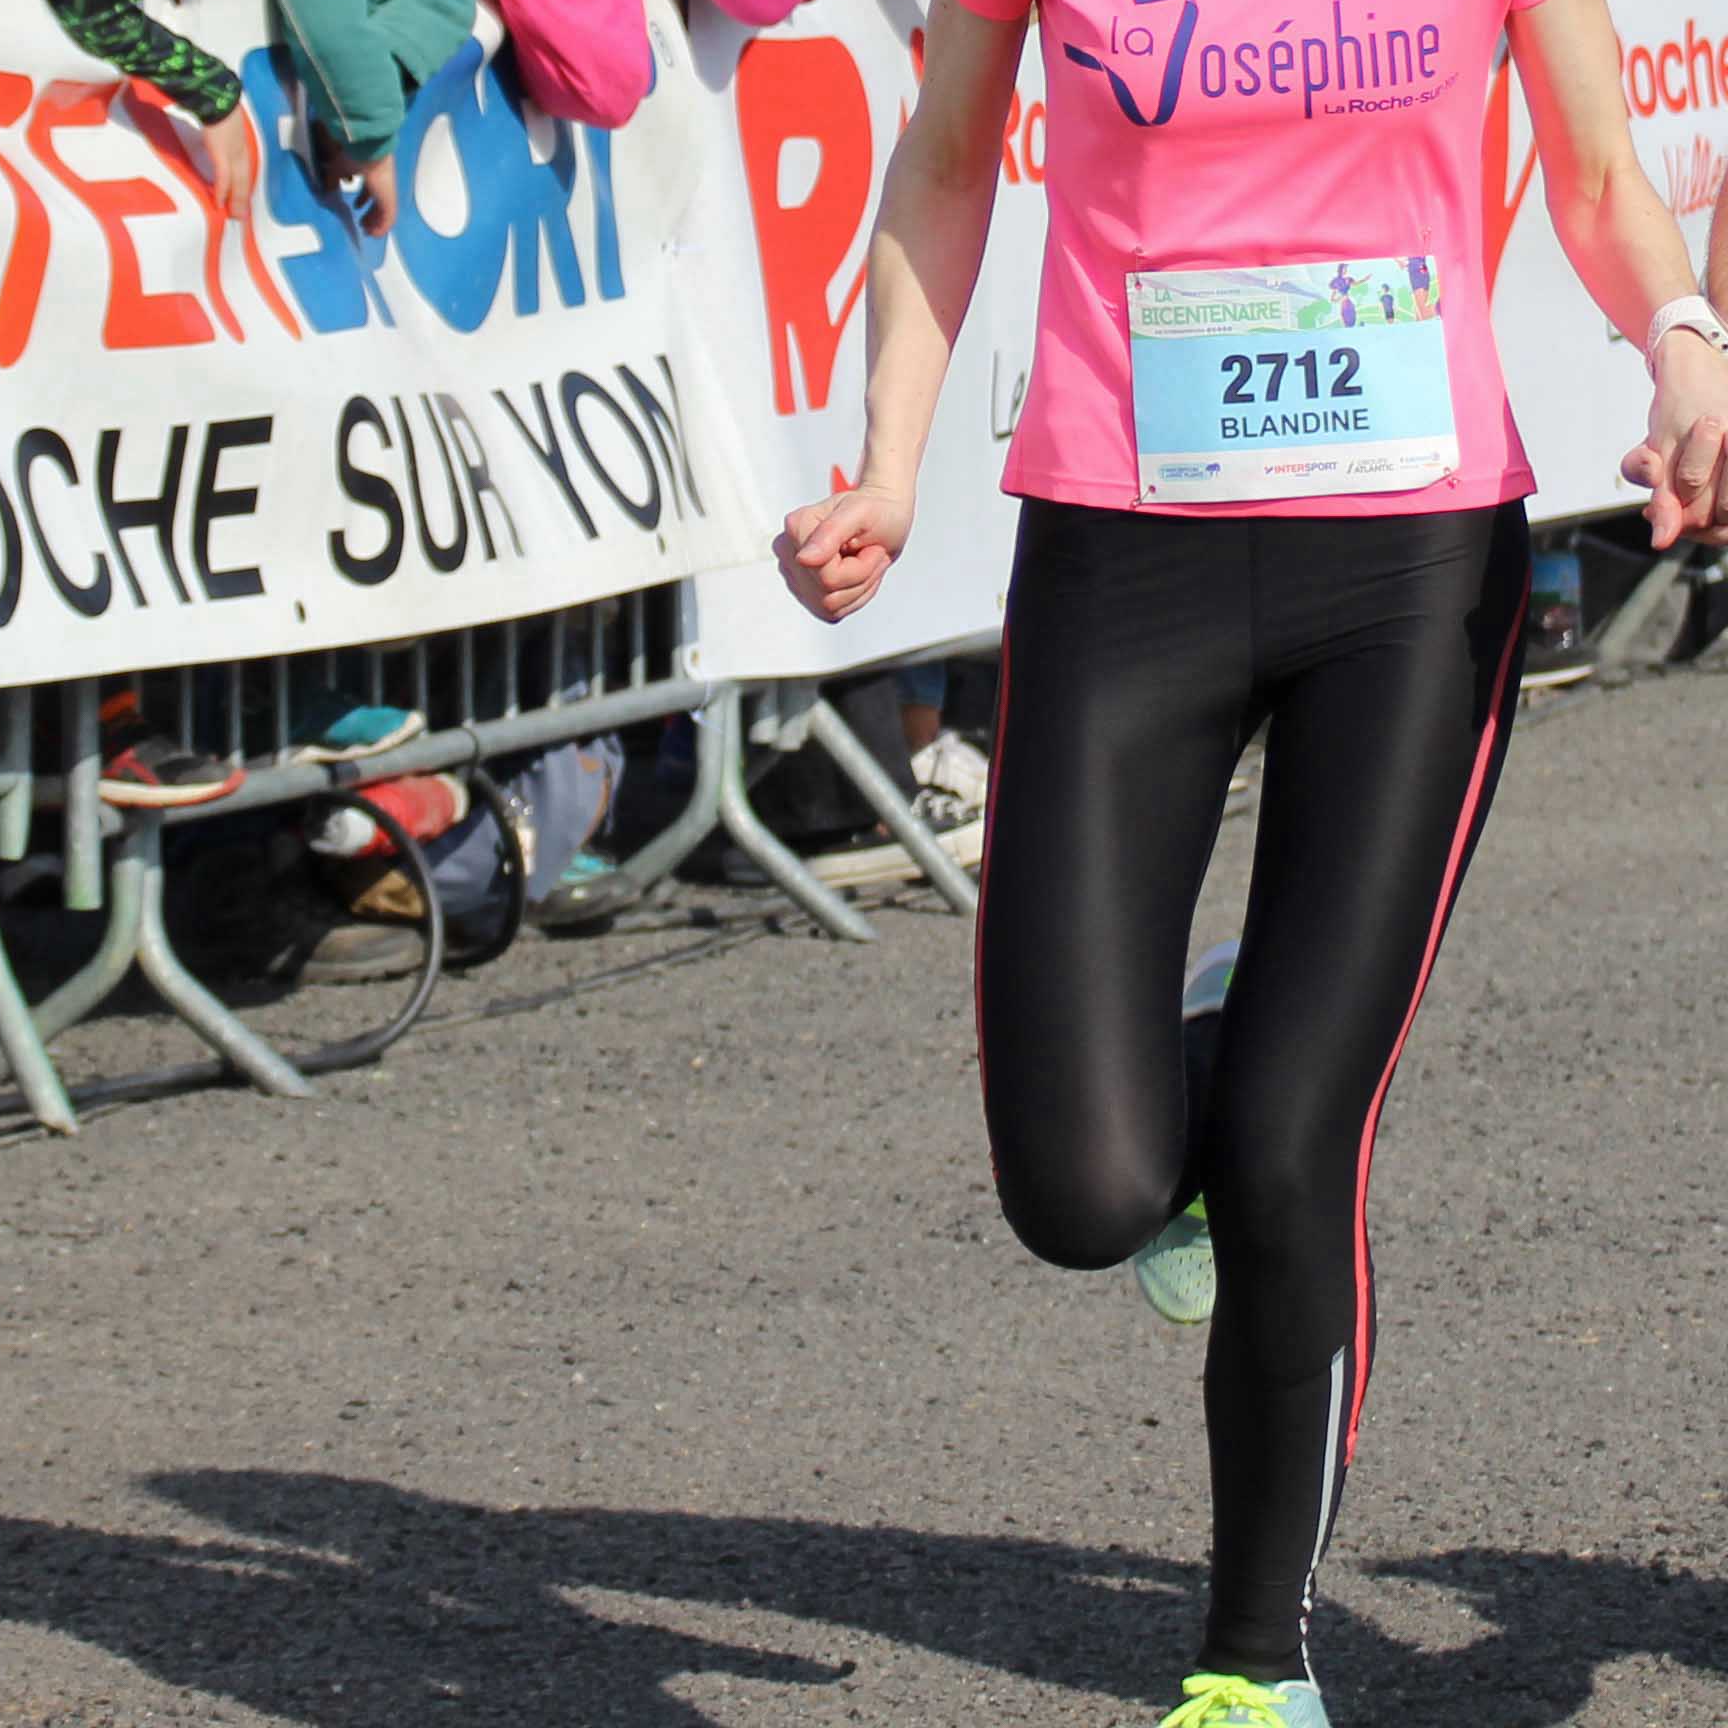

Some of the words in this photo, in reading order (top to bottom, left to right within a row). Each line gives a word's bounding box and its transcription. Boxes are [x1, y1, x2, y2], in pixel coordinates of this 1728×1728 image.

[1154, 289, 1173, 304] LA
[1140, 300, 1283, 327] BICENTENAIRE
[1220, 347, 1365, 406] 2712
[1220, 408, 1371, 440] BLANDINE
[328, 393, 524, 588] SUR
[495, 354, 708, 540] YON
[1274, 461, 1339, 474] INTERSPORT
